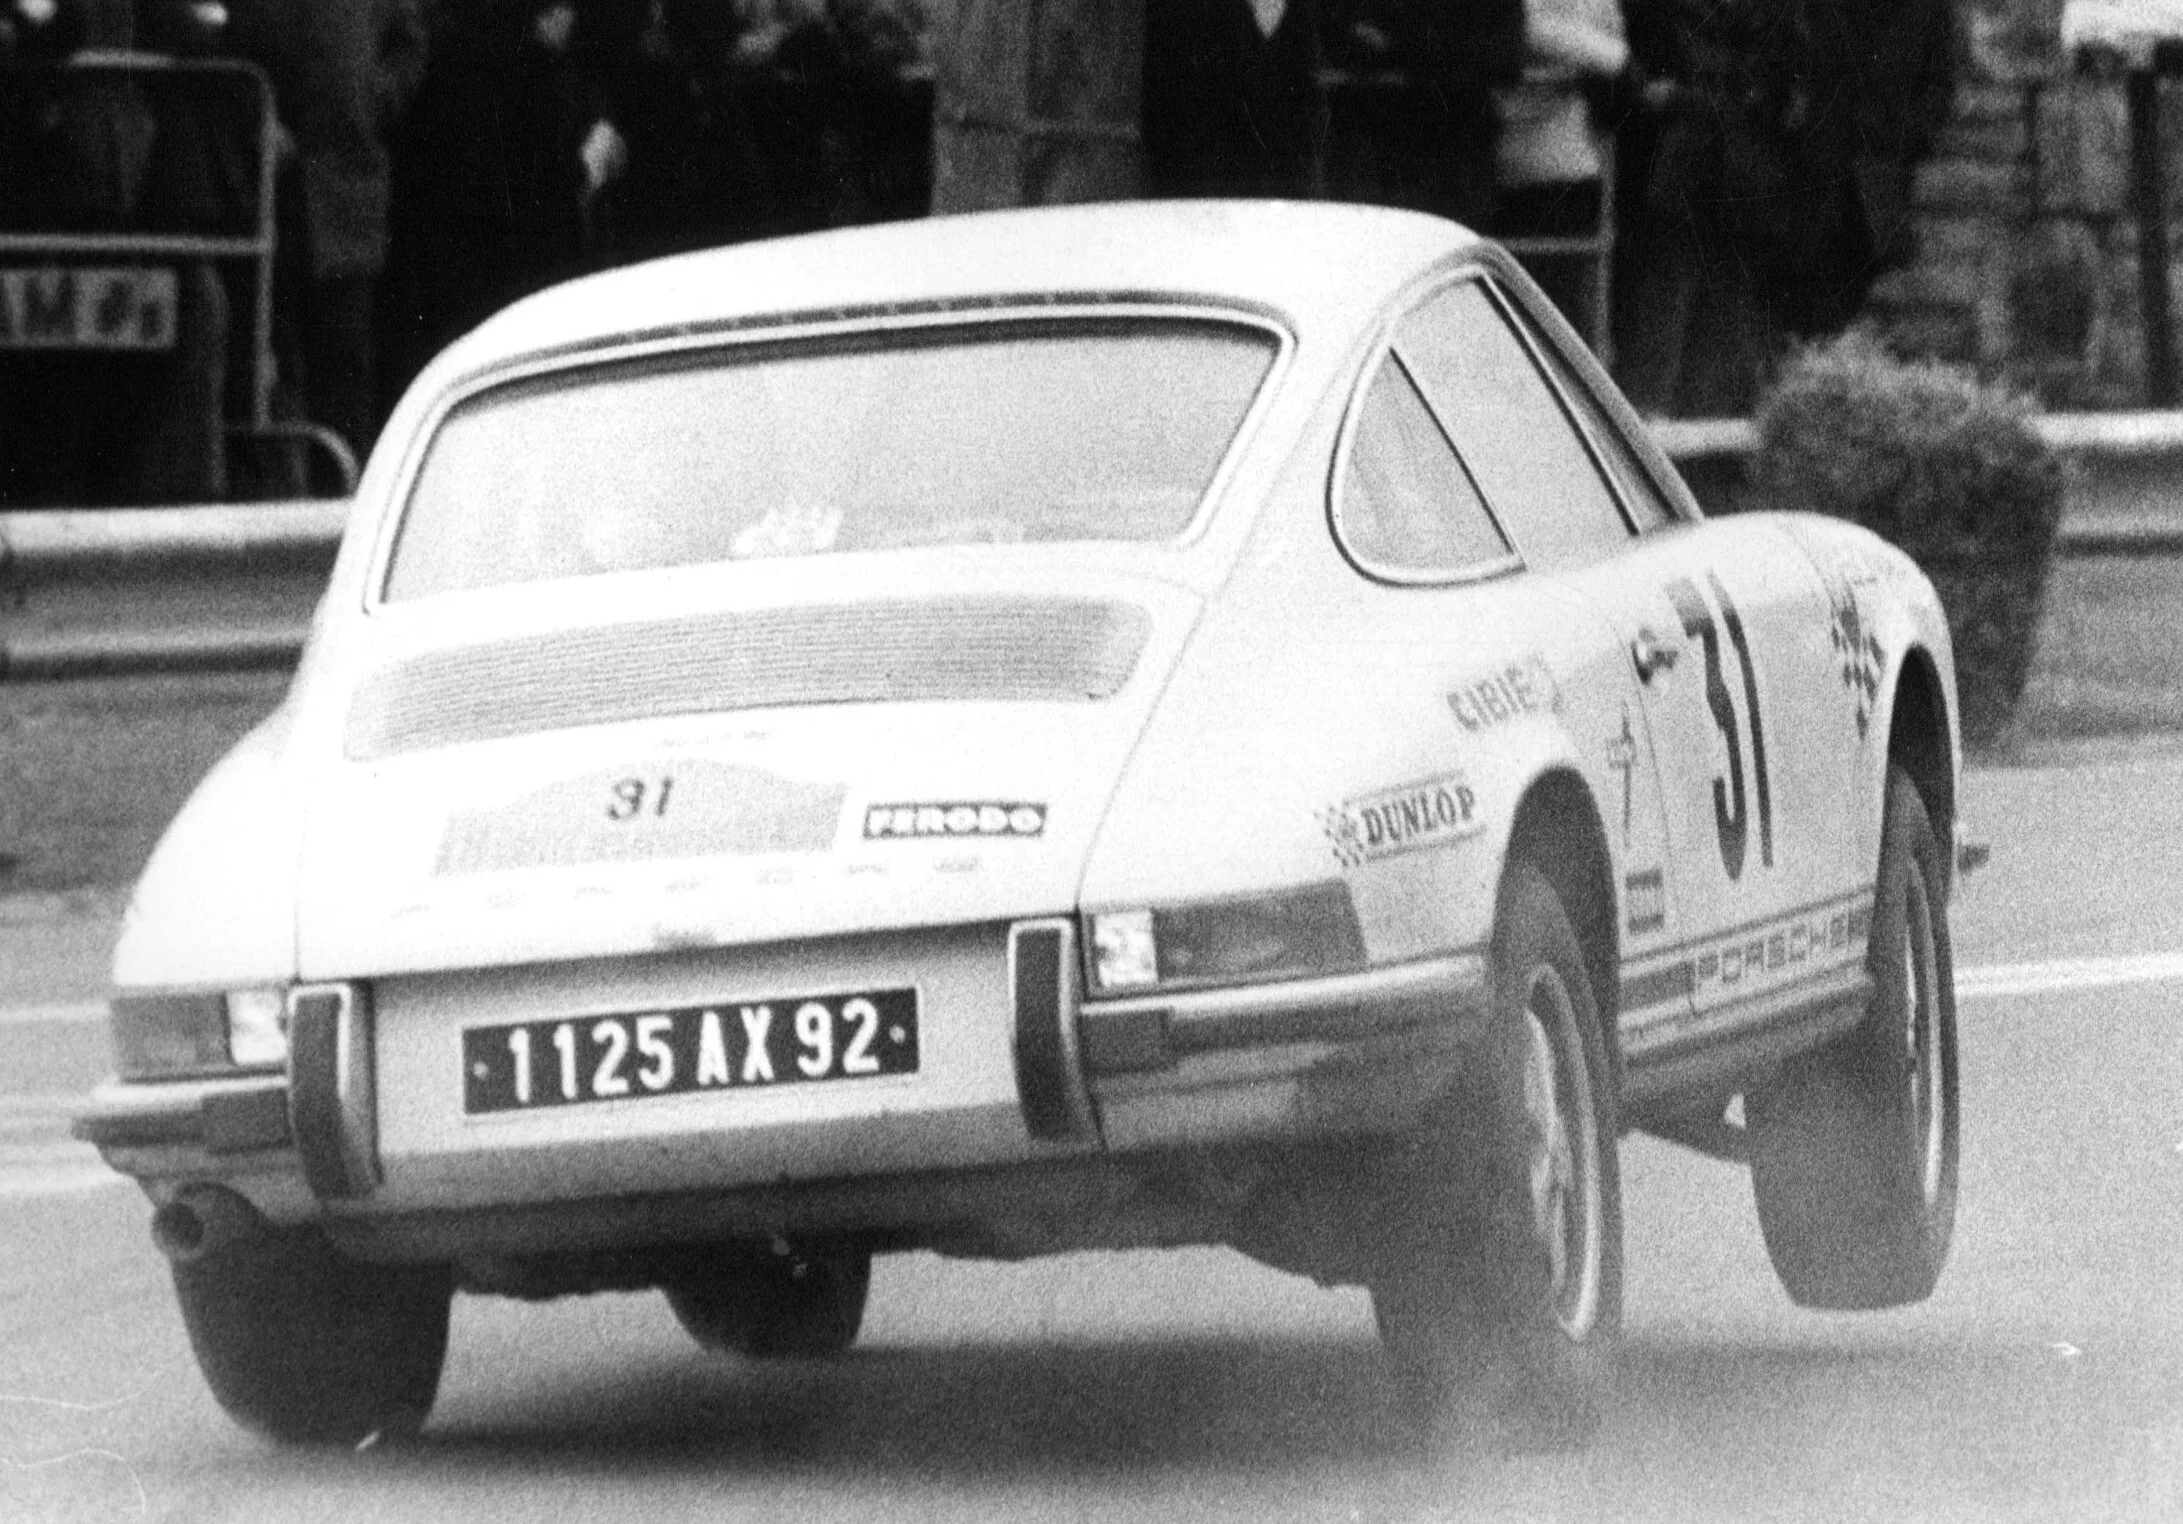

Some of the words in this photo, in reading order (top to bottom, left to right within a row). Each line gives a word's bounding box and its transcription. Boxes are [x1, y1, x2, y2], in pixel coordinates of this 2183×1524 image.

[1666, 572, 1775, 880] 31
[606, 774, 677, 820] 31
[868, 804, 1041, 836] FERODO
[1361, 785, 1476, 846] DUNLOP
[507, 1012, 676, 1103] 1125
[697, 1005, 775, 1087] AX
[795, 996, 881, 1078] 92
